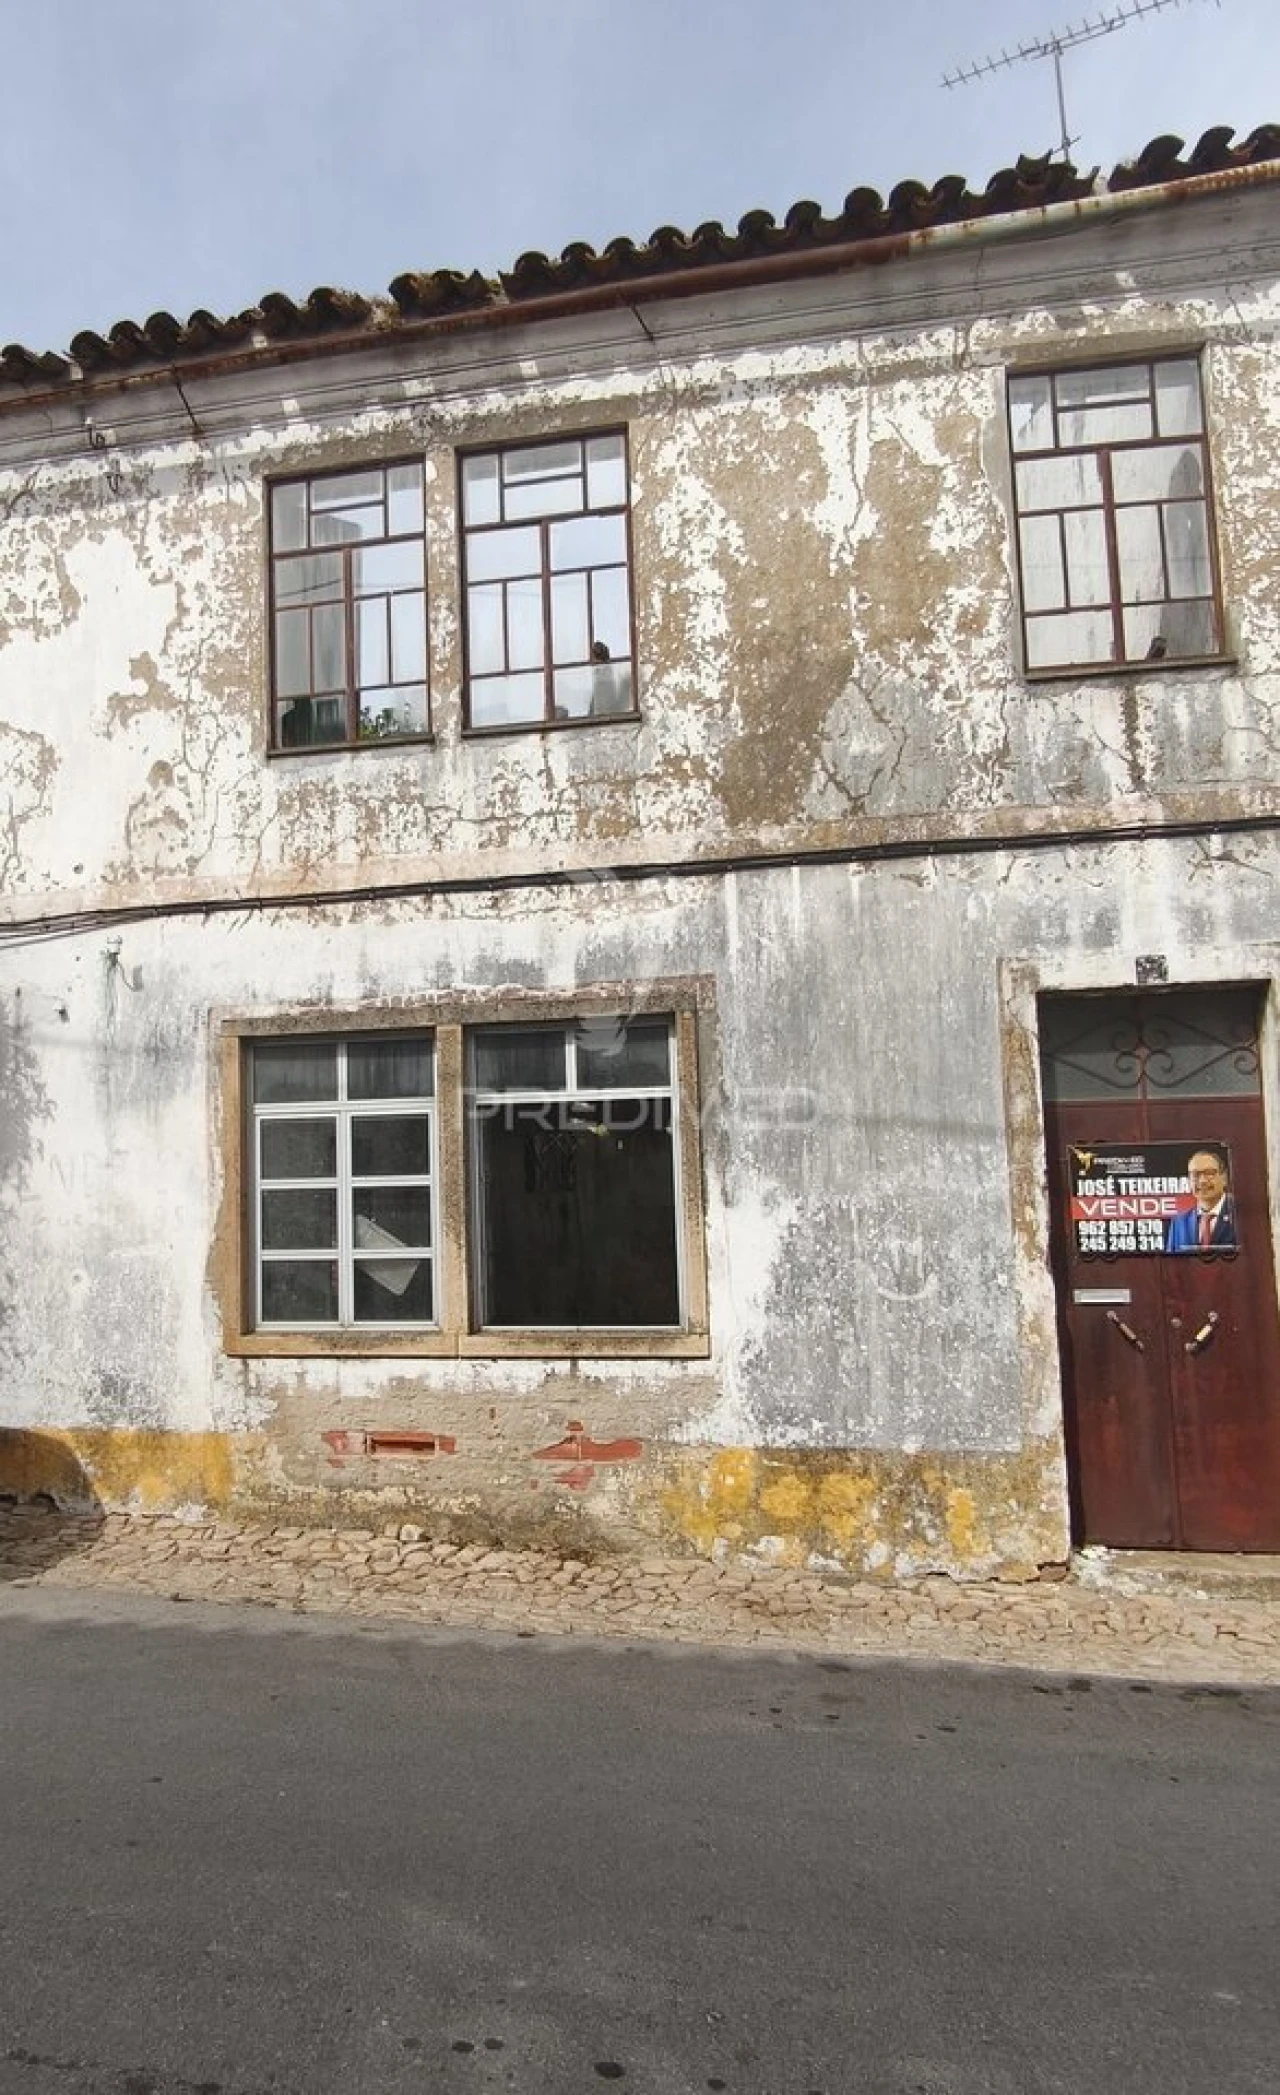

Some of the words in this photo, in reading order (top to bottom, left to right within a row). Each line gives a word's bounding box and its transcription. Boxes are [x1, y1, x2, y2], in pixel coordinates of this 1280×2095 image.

[1077, 1175, 1115, 1196] JOSÉ
[1117, 1177, 1191, 1195] TEIXEIRA
[1078, 1198, 1177, 1216] VENDE
[1079, 1220, 1106, 1235] 962
[1138, 1219, 1163, 1235] 570
[1080, 1236, 1107, 1251] 245
[1109, 1236, 1137, 1251] 249
[1139, 1236, 1164, 1250] 314
